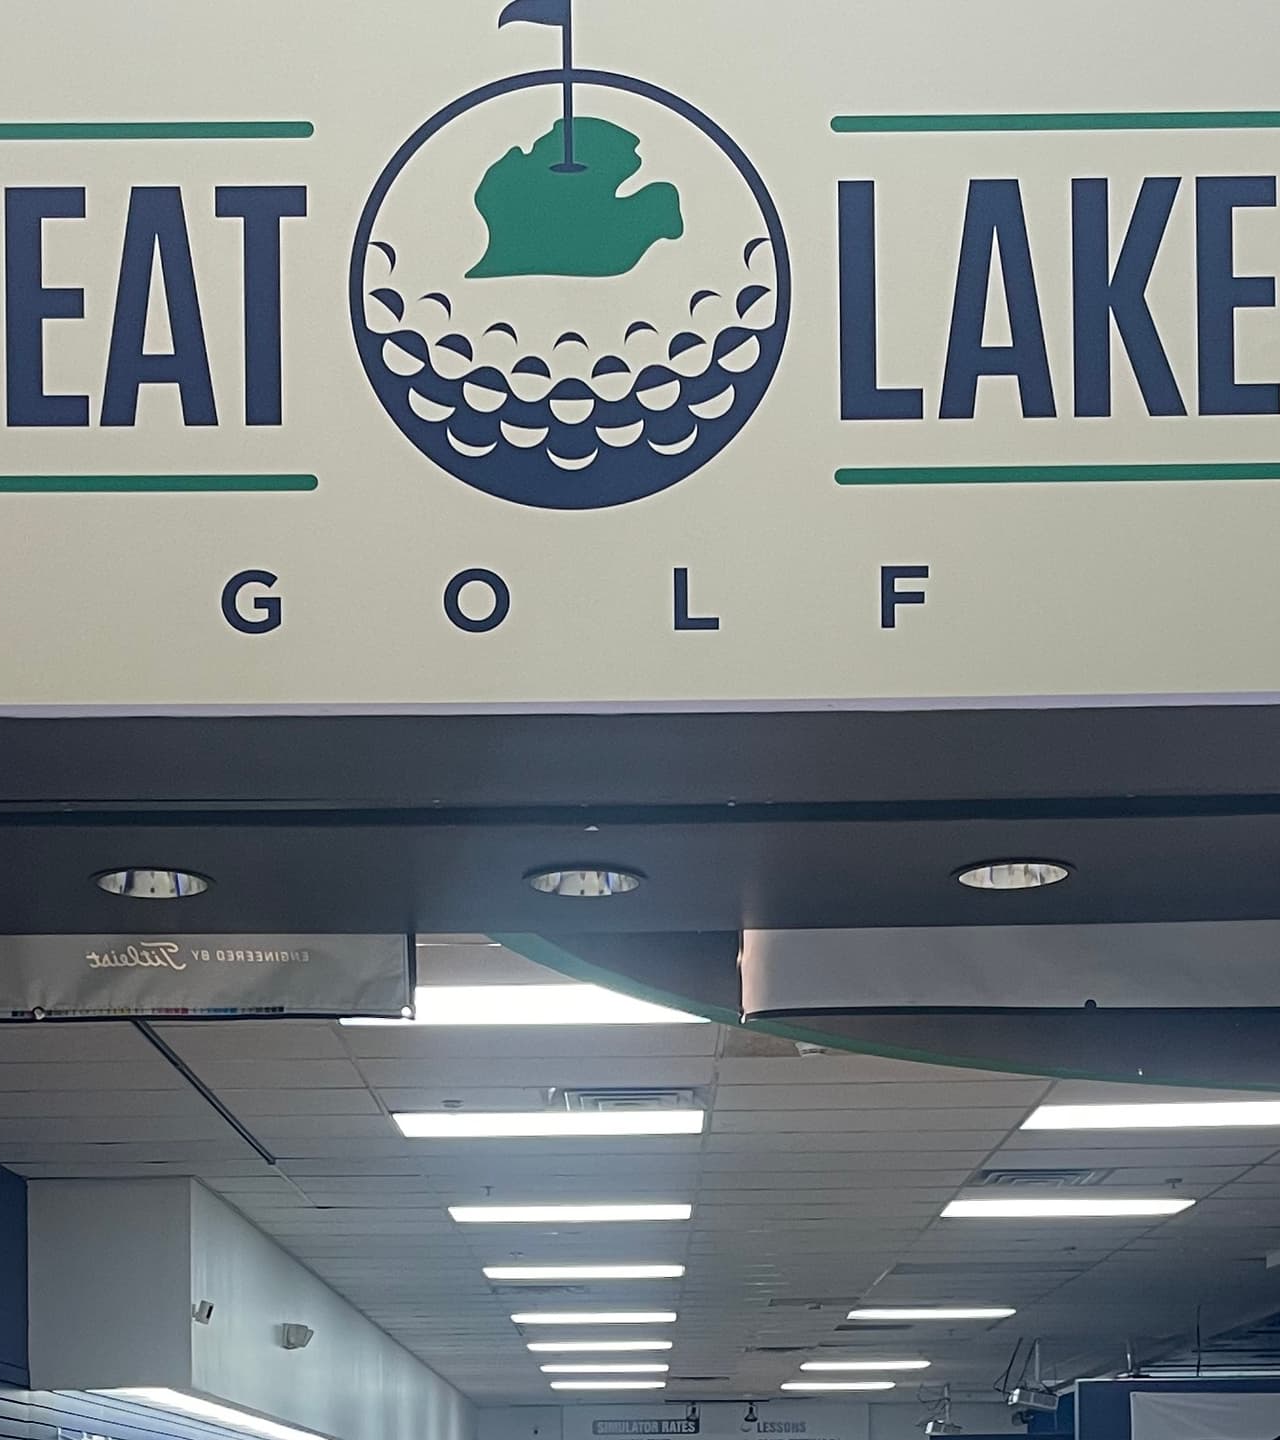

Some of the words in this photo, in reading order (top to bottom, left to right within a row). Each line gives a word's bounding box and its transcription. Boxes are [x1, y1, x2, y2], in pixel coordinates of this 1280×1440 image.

[221, 565, 930, 635] GOLF
[597, 1421, 659, 1433] SIMULATOR
[661, 1420, 696, 1433] RATES
[757, 1422, 807, 1433] LESSONS
